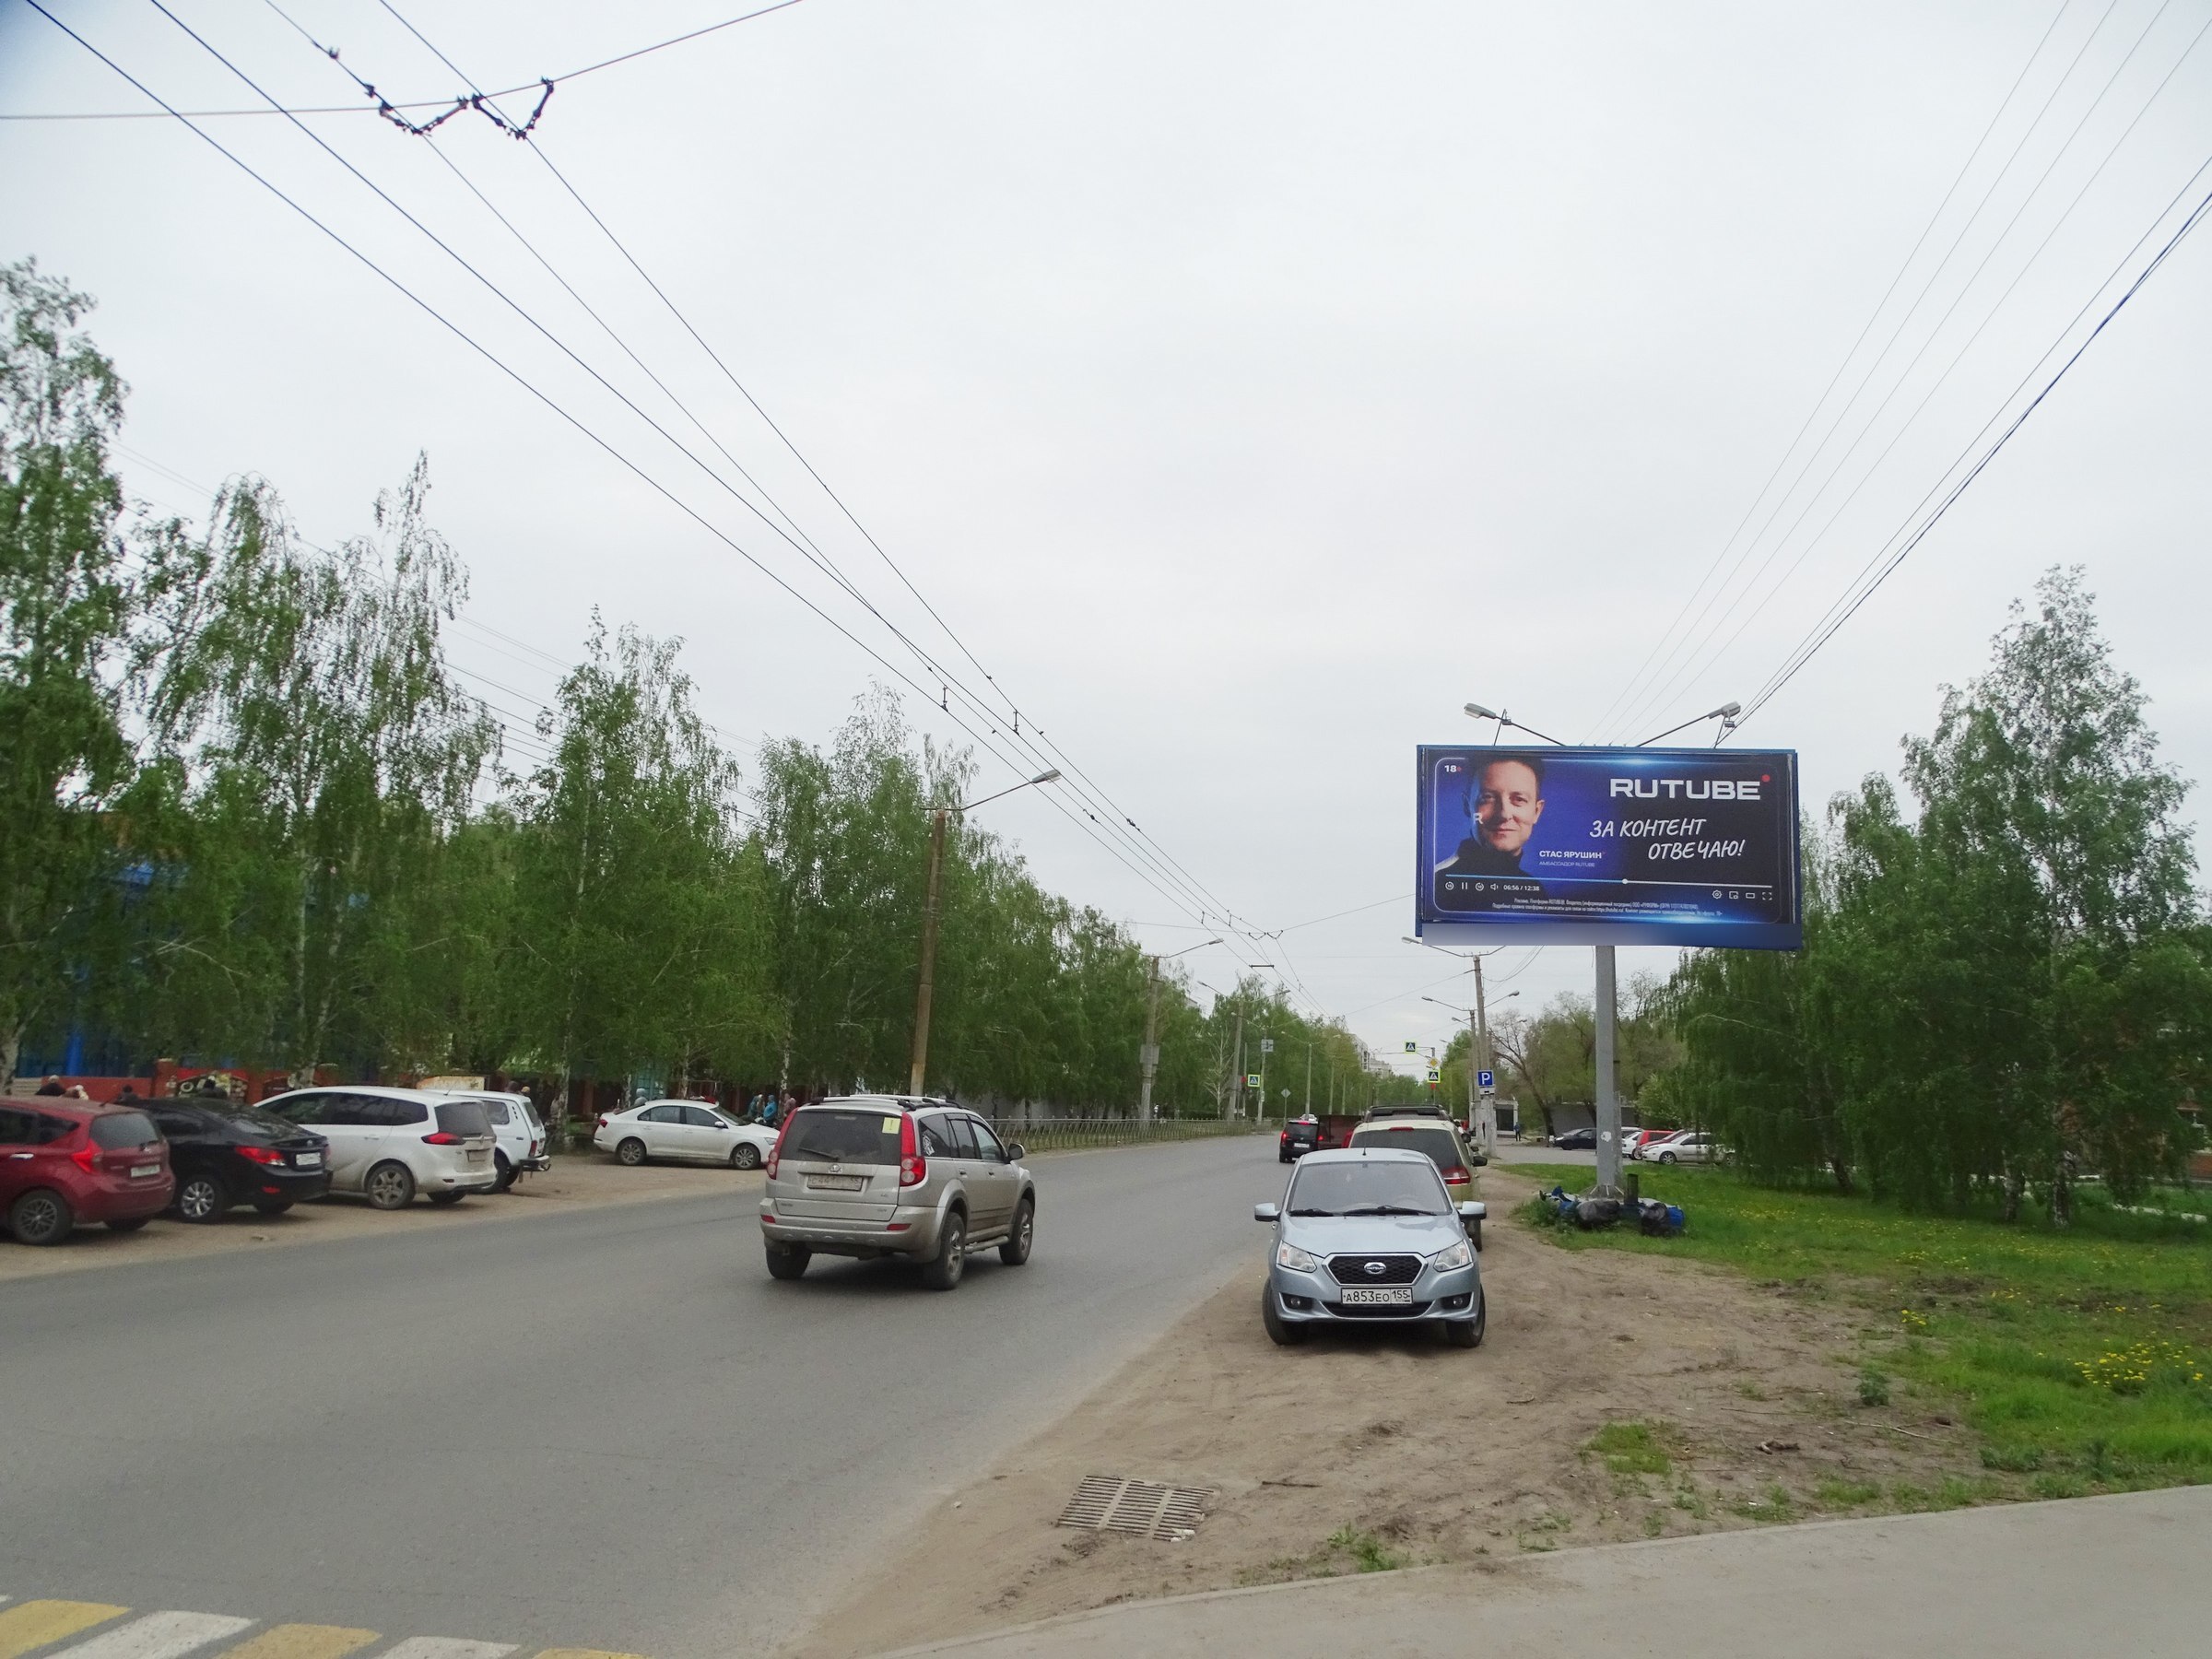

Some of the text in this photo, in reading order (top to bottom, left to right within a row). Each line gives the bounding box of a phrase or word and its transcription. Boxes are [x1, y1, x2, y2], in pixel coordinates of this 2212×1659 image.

[1609, 778, 1761, 801] RUTUBE
[1589, 818, 1707, 838] ЗА КОНТЕНТ
[1539, 850, 1603, 859] СТАС ЯРУШИН
[1648, 839, 1745, 861] ОТВЕЧАЮ!
[1481, 1072, 1491, 1085] P
[1346, 1289, 1408, 1302] А853ЕО 155
